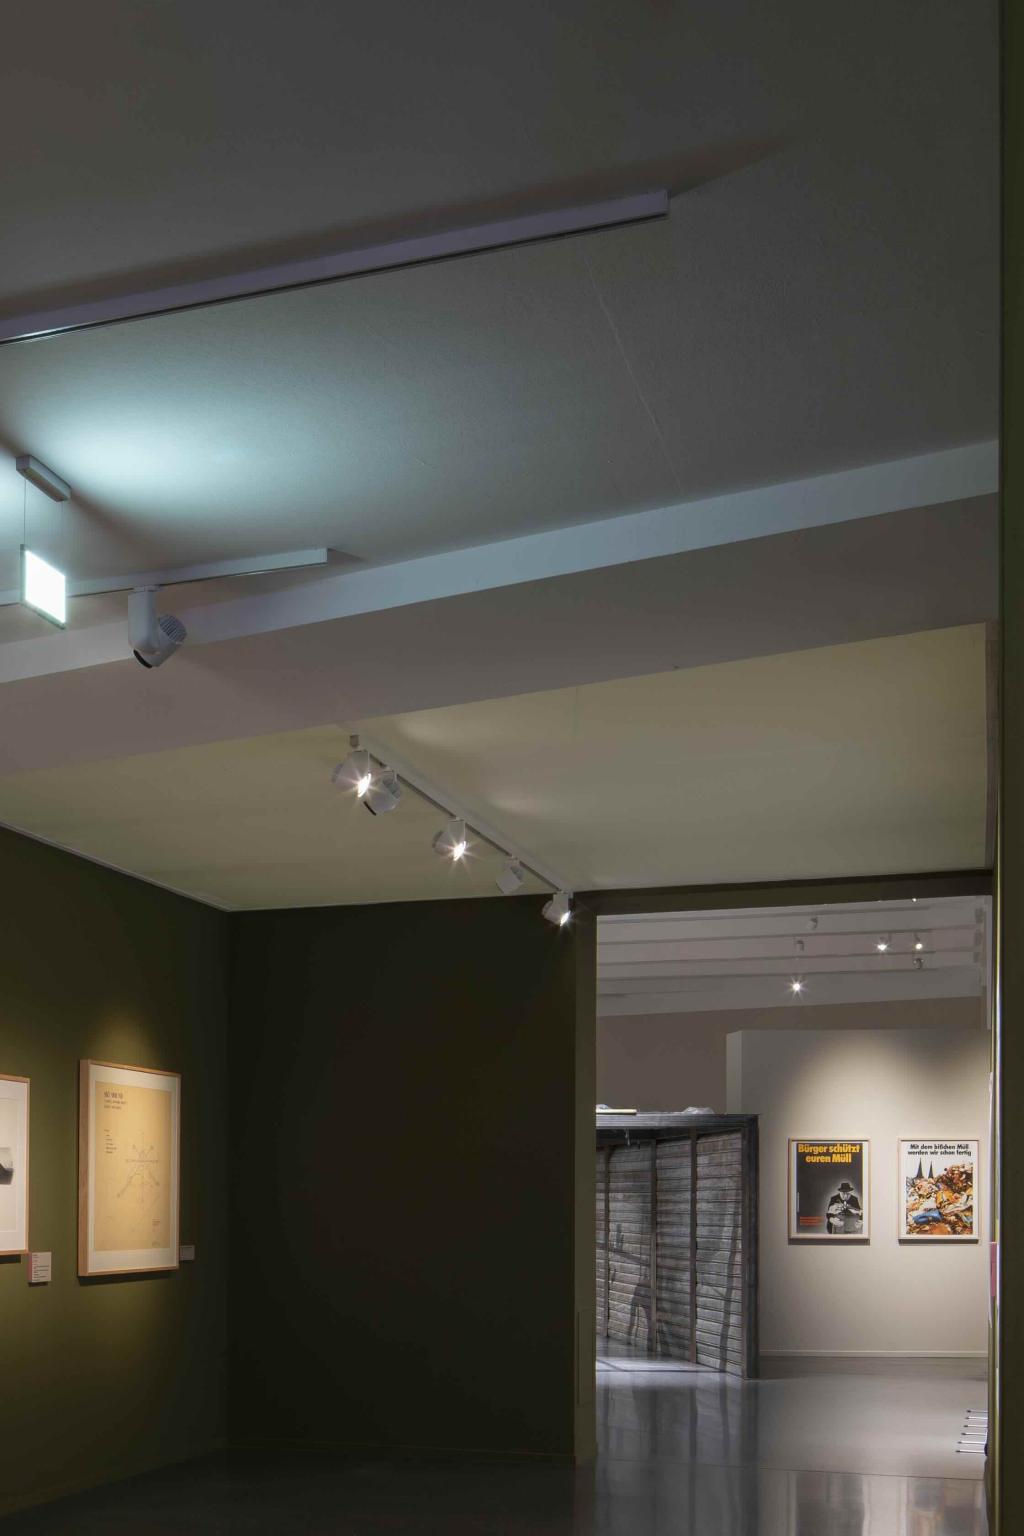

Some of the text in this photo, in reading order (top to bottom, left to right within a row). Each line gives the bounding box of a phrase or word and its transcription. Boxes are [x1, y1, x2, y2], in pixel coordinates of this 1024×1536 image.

[798, 1144, 860, 1154] Bürger schützt
[832, 1153, 852, 1162] Müll
